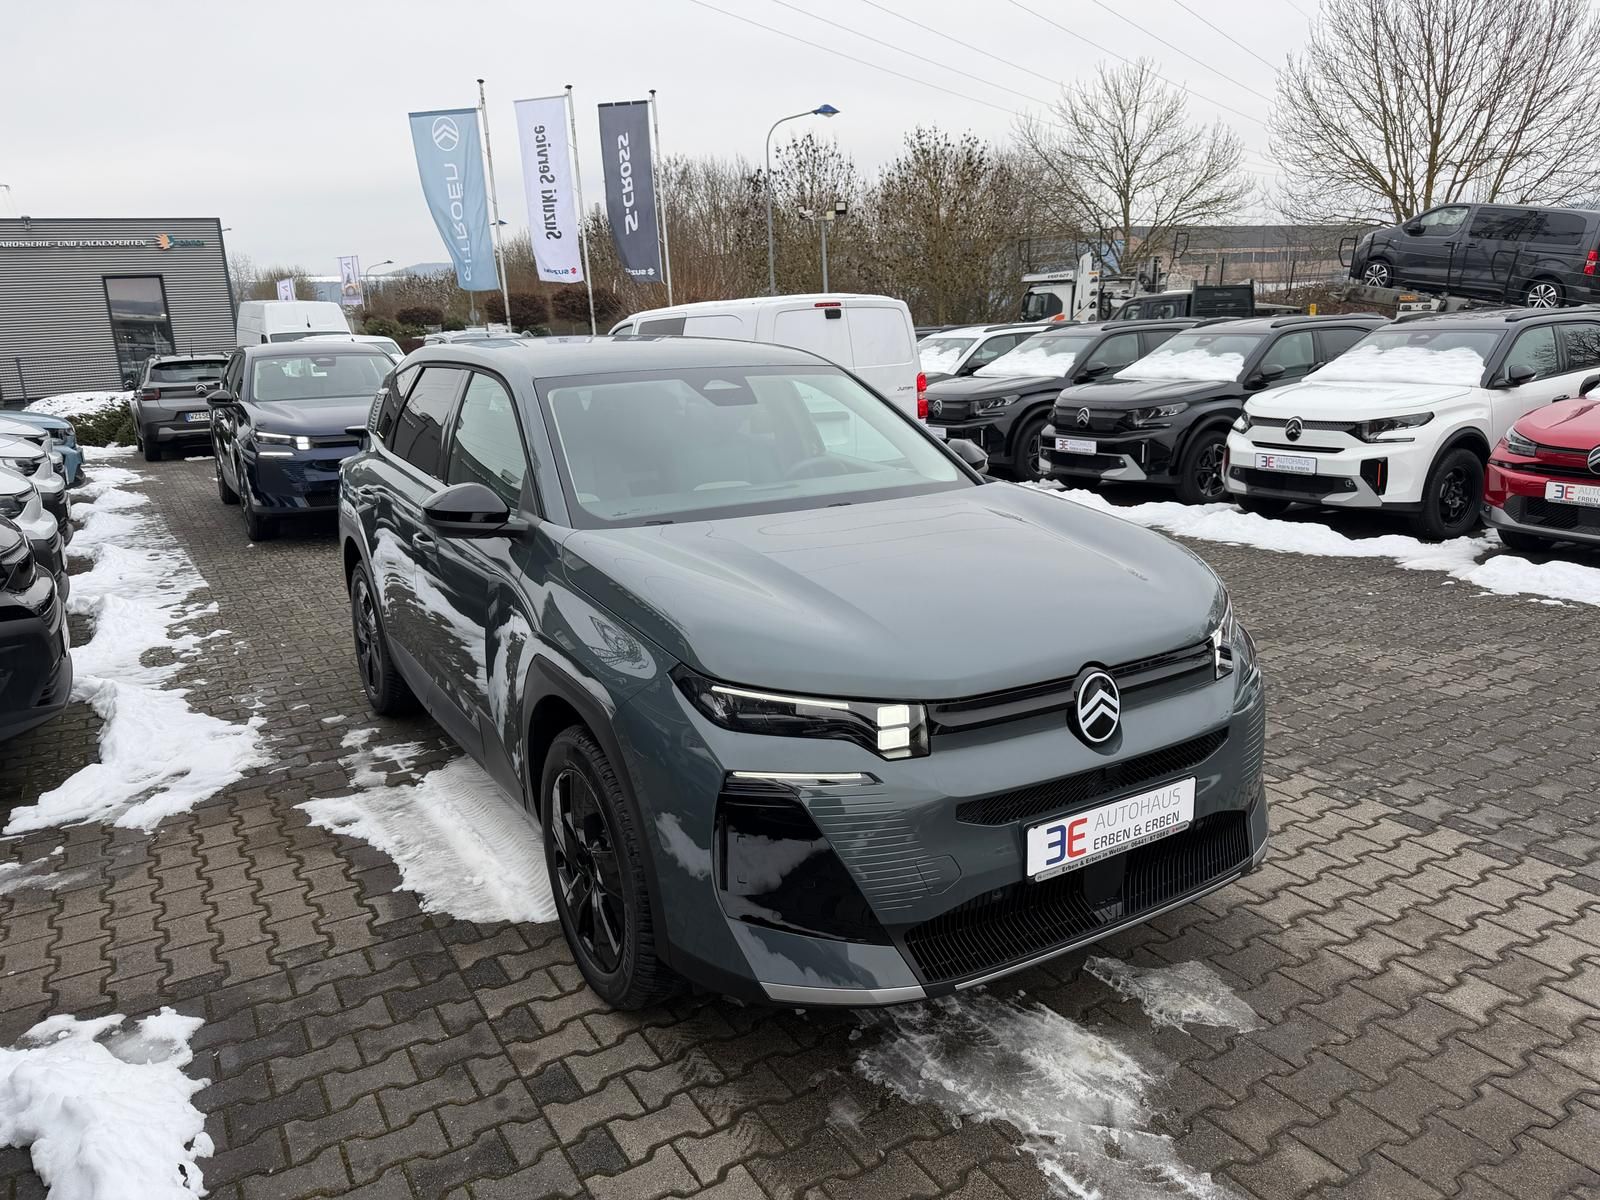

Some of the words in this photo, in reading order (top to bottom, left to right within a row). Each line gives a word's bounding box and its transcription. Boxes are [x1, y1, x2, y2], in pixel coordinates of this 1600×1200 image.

[79, 239, 147, 247] LACKEXPERTEN
[1094, 786, 1181, 832] AUTOHAUS
[1093, 827, 1131, 851] ERBEN
[1133, 823, 1143, 837] &
[1145, 810, 1180, 833] ERBEN
[1061, 863, 1079, 873] Erben
[1085, 854, 1102, 864] Erben
[1109, 844, 1129, 856] Wetzlar
